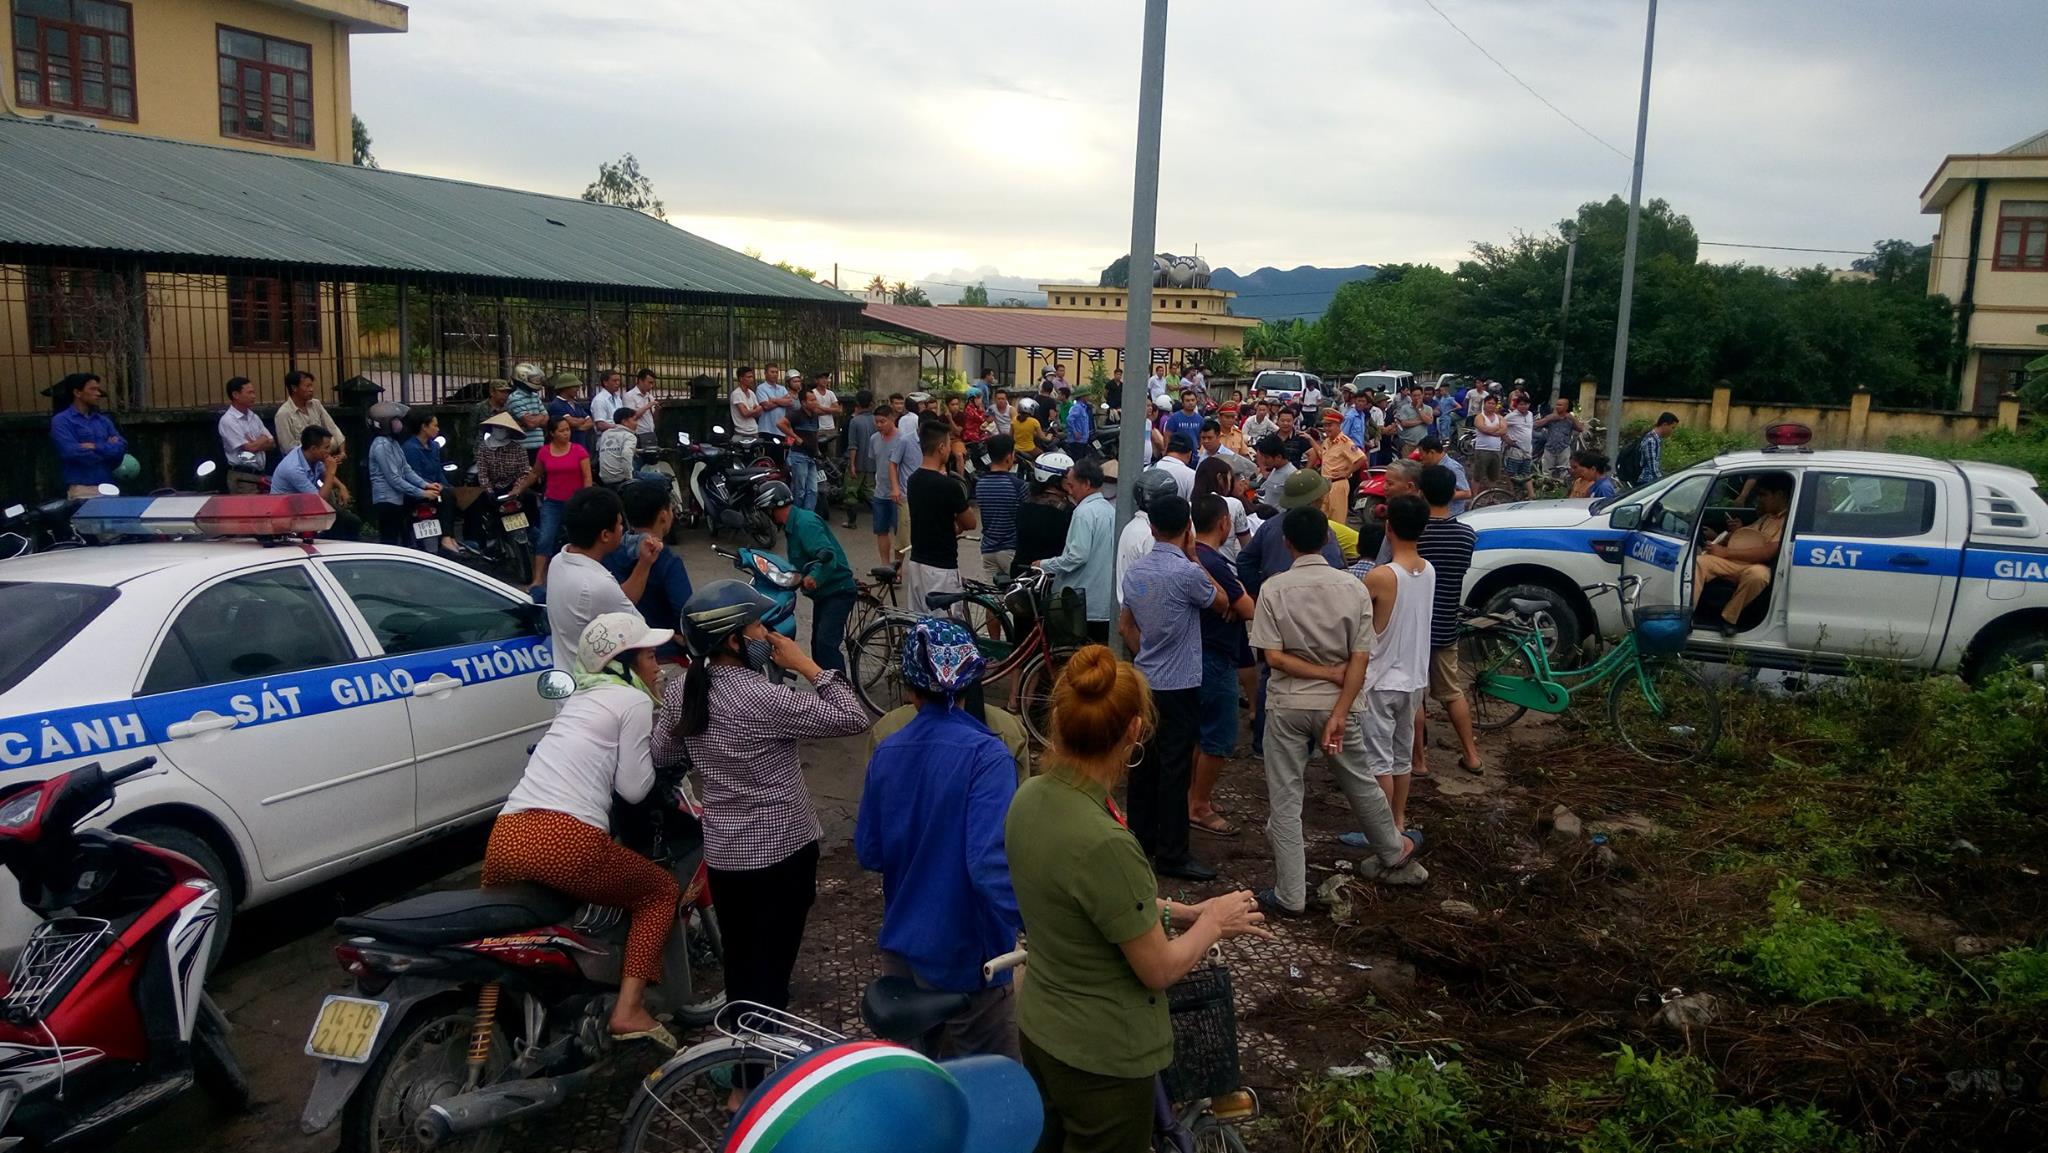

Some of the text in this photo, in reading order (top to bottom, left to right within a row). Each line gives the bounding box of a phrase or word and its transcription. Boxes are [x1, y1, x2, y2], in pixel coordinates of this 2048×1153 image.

[1810, 545, 1862, 567] SÁT
[1994, 560, 2048, 579] GIA
[0, 645, 553, 765] CẢNH SÁT GIAO THÔNG
